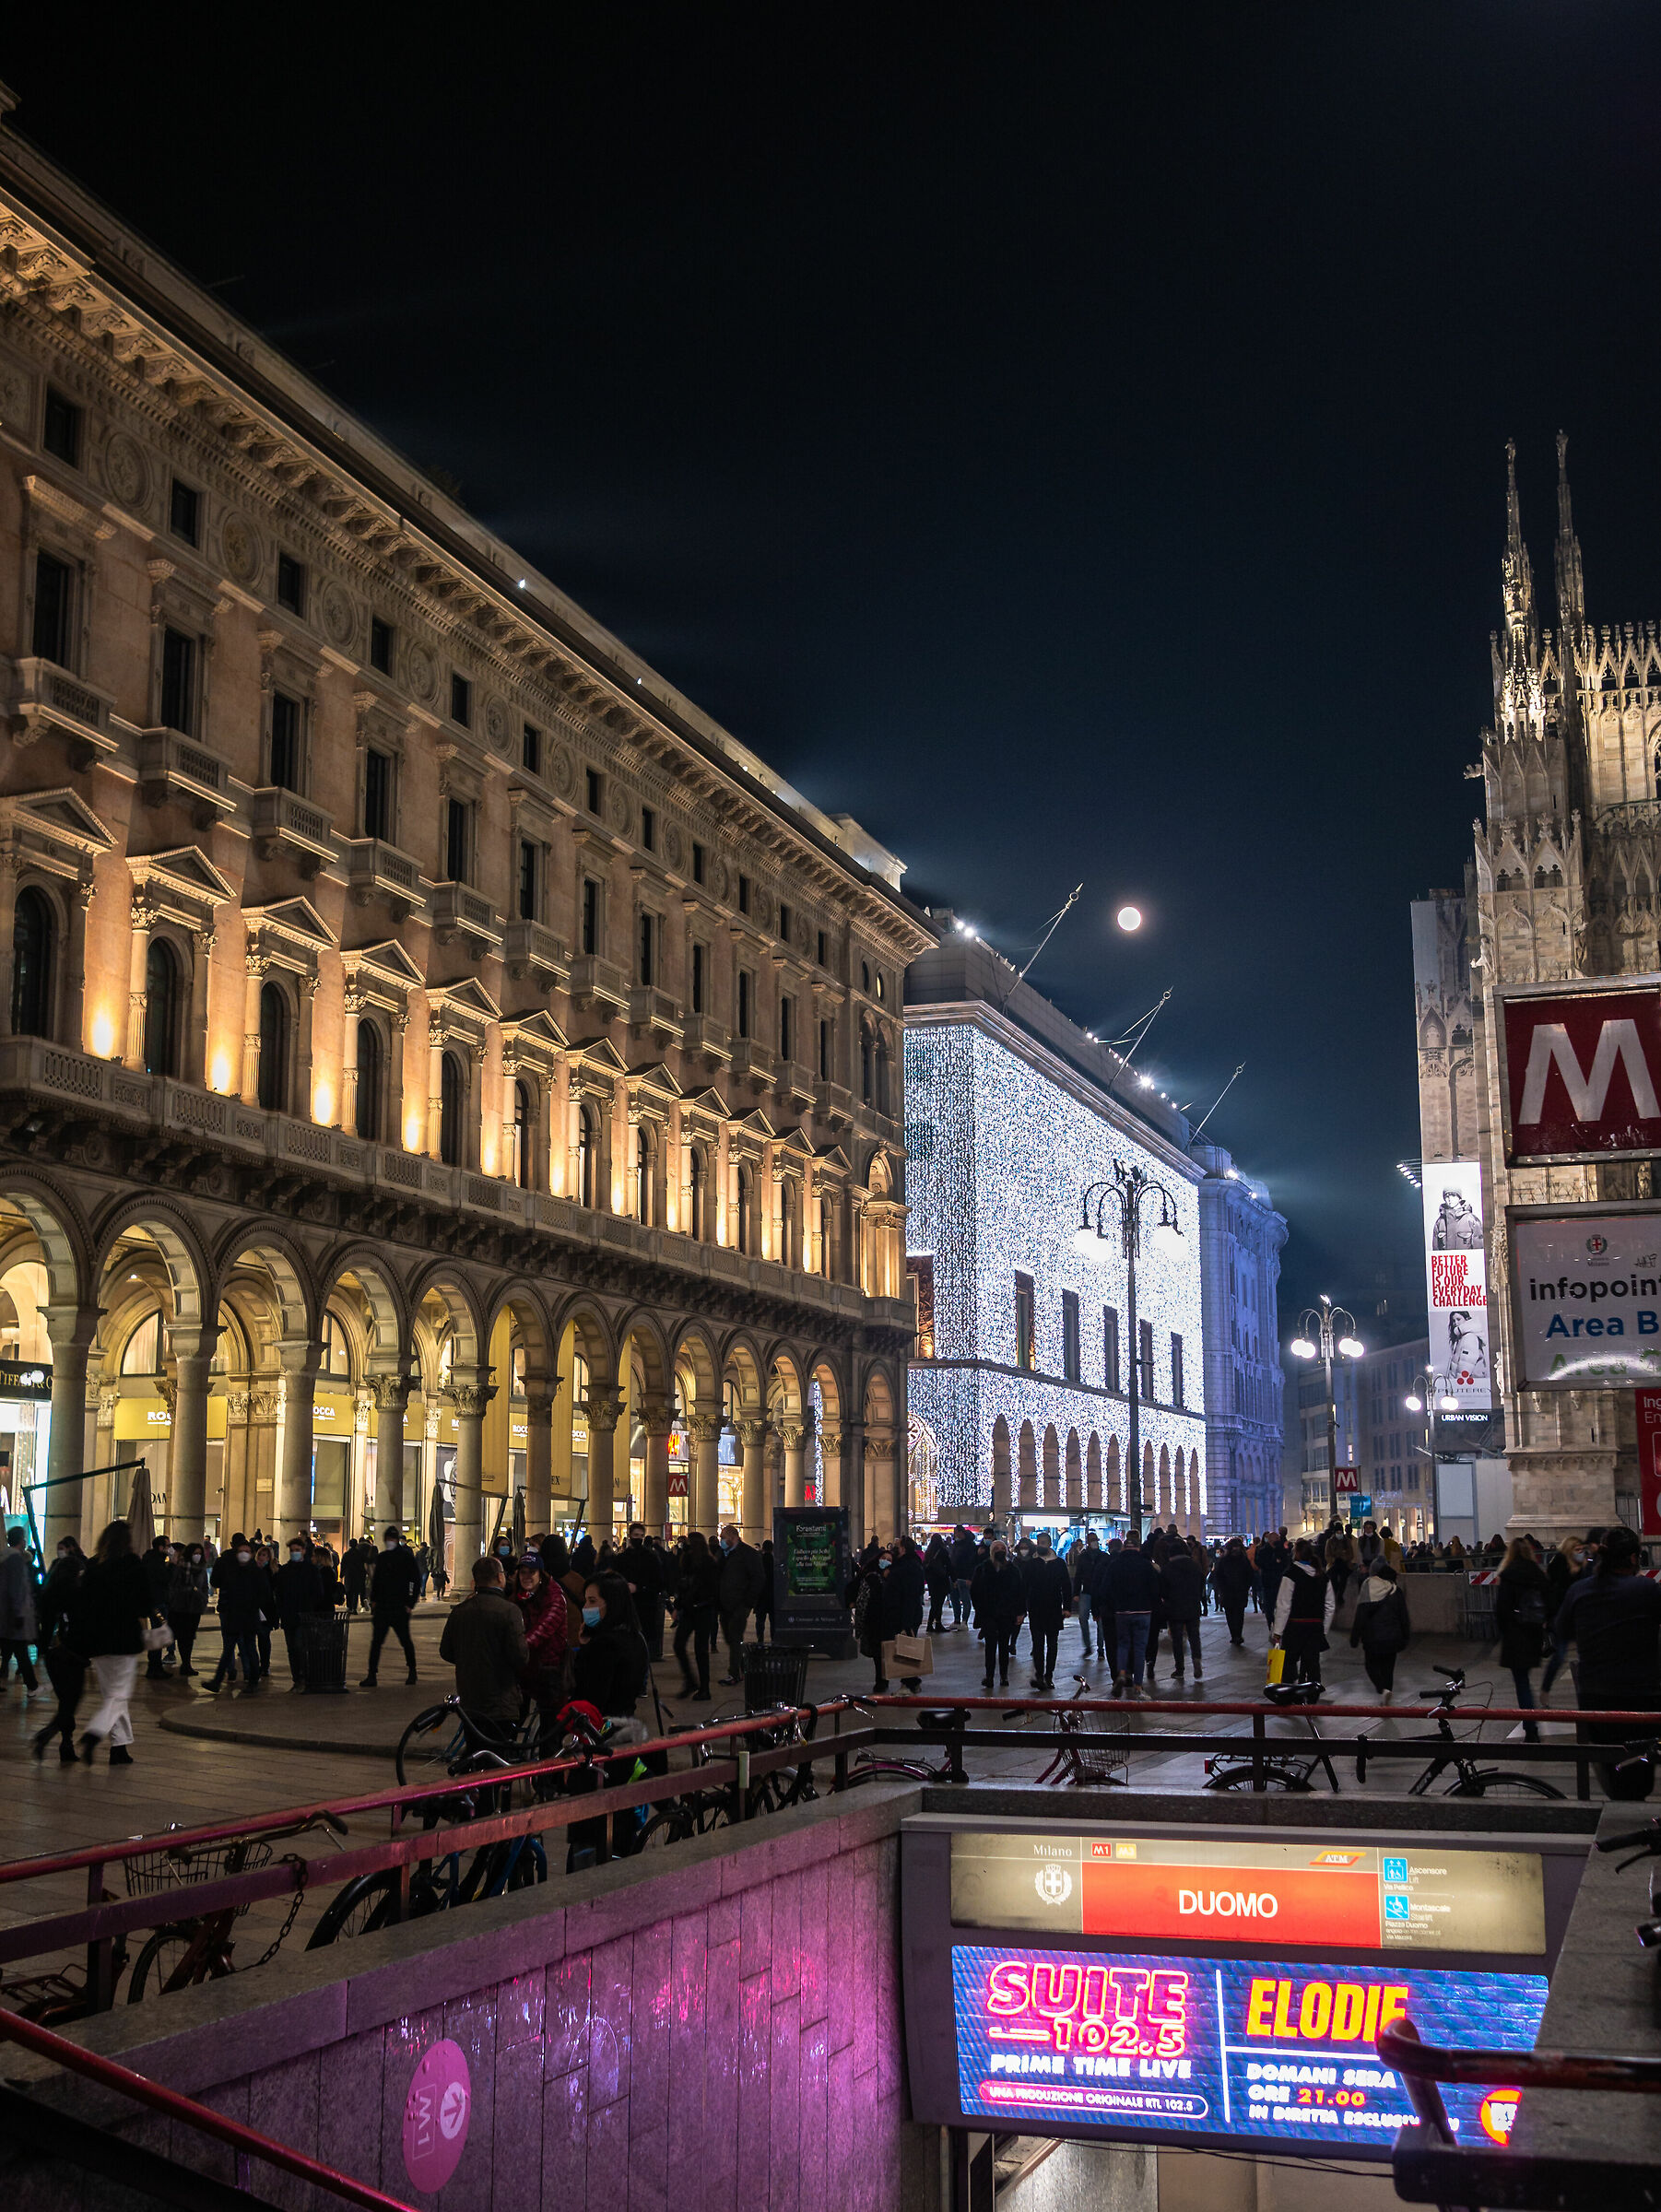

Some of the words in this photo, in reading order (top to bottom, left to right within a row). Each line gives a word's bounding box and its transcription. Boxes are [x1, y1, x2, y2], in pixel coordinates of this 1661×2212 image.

[1519, 1018, 1661, 1124] M
[1431, 1255, 1467, 1266] BETTER
[1432, 1265, 1468, 1276] FUTURE
[1432, 1276, 1442, 1287] IS
[1444, 1276, 1464, 1286] OUR
[1432, 1286, 1481, 1297] EVERYDAY
[1433, 1296, 1487, 1307] CHALLENGE
[1546, 1313, 1624, 1338] Area
[1637, 1311, 1659, 1335] B
[669, 1478, 687, 1492] M
[1337, 1471, 1357, 1488] M
[1033, 1844, 1072, 1856] Milano
[1093, 1845, 1109, 1854] M1
[1325, 1853, 1349, 1863] ATM
[1409, 1866, 1447, 1876] Ascensore
[1179, 1889, 1278, 1918] DUOMO
[986, 1960, 1189, 2025] SUITE
[1054, 2017, 1186, 2057] 102.5
[990, 2053, 1065, 2075] PRIME
[1073, 2056, 1131, 2077] TIME
[1139, 2059, 1192, 2079] LIVE
[1246, 2063, 1337, 2085] DOMANI
[1343, 2069, 1396, 2088] SERA
[989, 2086, 1014, 2099] UNA
[1015, 2088, 1084, 2104] PRODUZIONE
[1086, 2092, 1144, 2108] ORIGINALE
[1145, 2097, 1162, 2110] RTL
[1165, 2099, 1194, 2112] 102.5
[1247, 2084, 1290, 2103] ORE
[1298, 2088, 1366, 2107] 21.00
[1249, 2104, 1268, 2119] IN
[1273, 2106, 1339, 2124] DIRETTA
